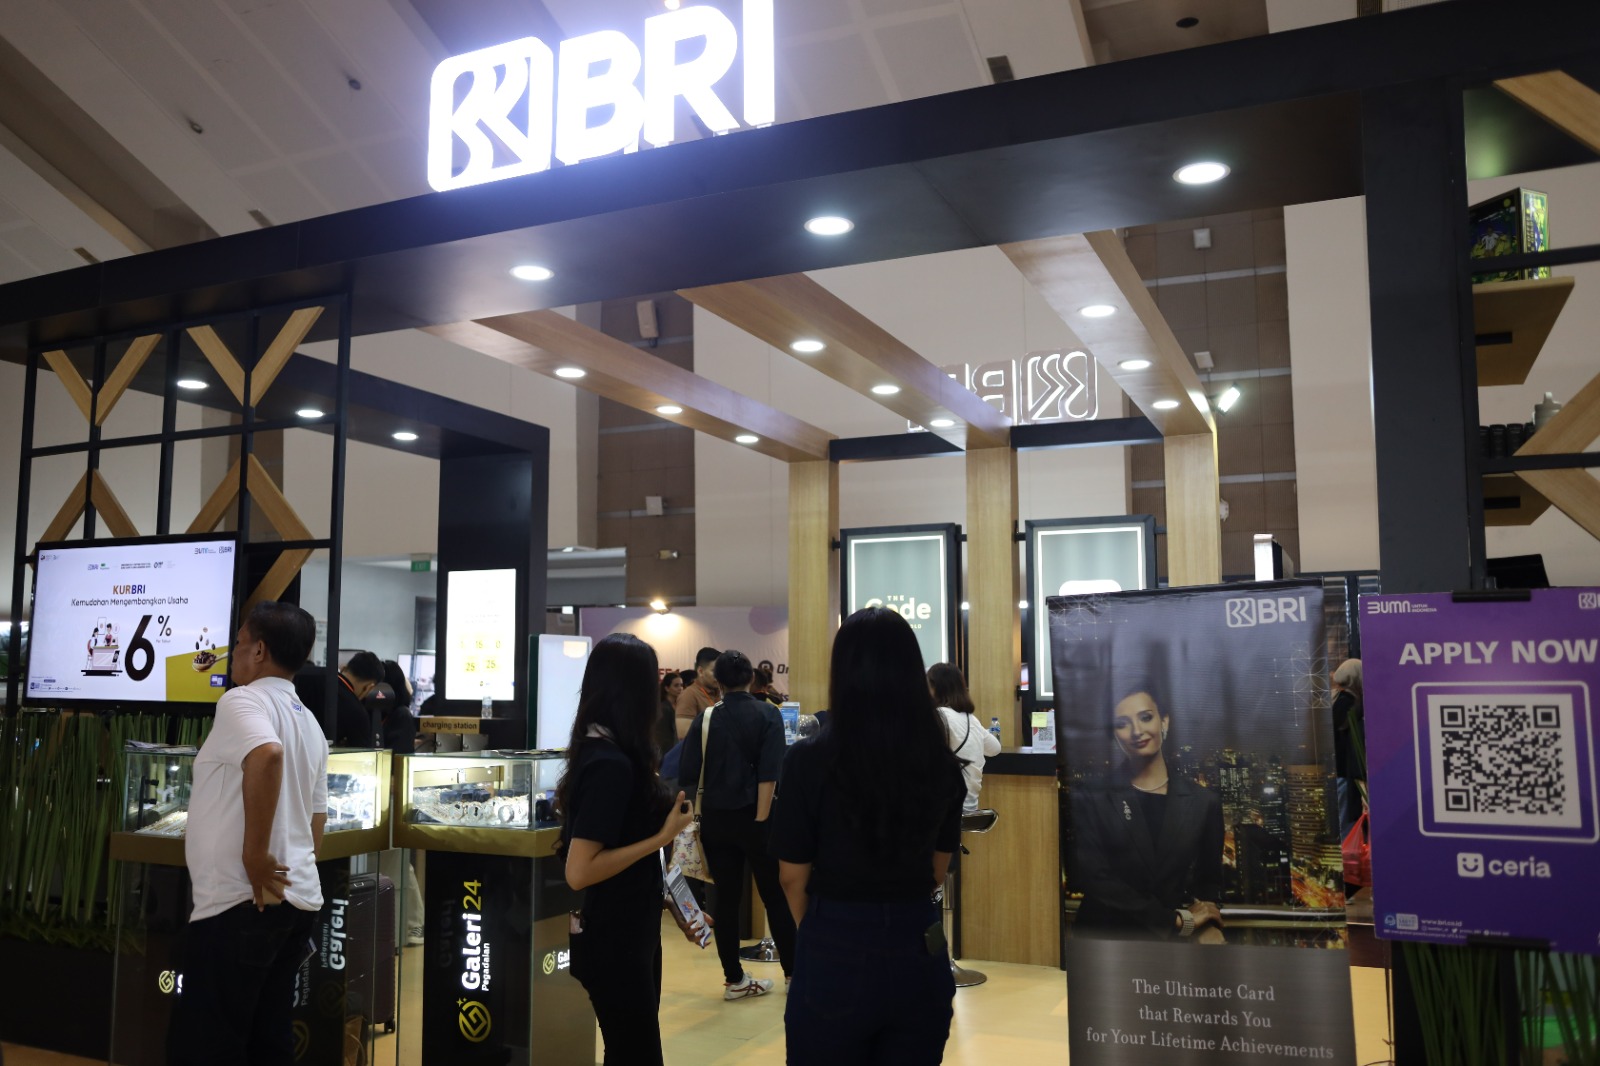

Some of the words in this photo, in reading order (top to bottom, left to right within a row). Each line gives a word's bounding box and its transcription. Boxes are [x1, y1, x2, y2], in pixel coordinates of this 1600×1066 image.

[555, 0, 775, 161] BRI
[113, 584, 146, 595] KURBRI
[71, 598, 109, 607] Kemudahan
[110, 597, 166, 607] Mengembangkan
[167, 596, 189, 605] Usaha
[1258, 596, 1307, 624] BRI
[1367, 600, 1411, 614] BUMN
[1399, 641, 1499, 665] APPLY
[1511, 639, 1598, 664] NOW
[423, 721, 452, 730] charging
[453, 721, 477, 730] station
[1488, 856, 1552, 878] ceria
[463, 879, 482, 911] 24
[461, 912, 482, 990] Galeri
[558, 949, 570, 963] Gal
[481, 942, 491, 991] Pegadaian
[1132, 978, 1161, 995] The
[1165, 980, 1232, 999] Ultimate
[1237, 983, 1275, 1001] Card
[1139, 1006, 1168, 1022] that
[1173, 1007, 1238, 1026] Rewards
[1242, 1011, 1272, 1028] You
[1087, 1027, 1108, 1043] for
[1111, 1029, 1147, 1045] Your
[1151, 1031, 1216, 1051] Lifetime
[1221, 1035, 1334, 1060] Achievements
